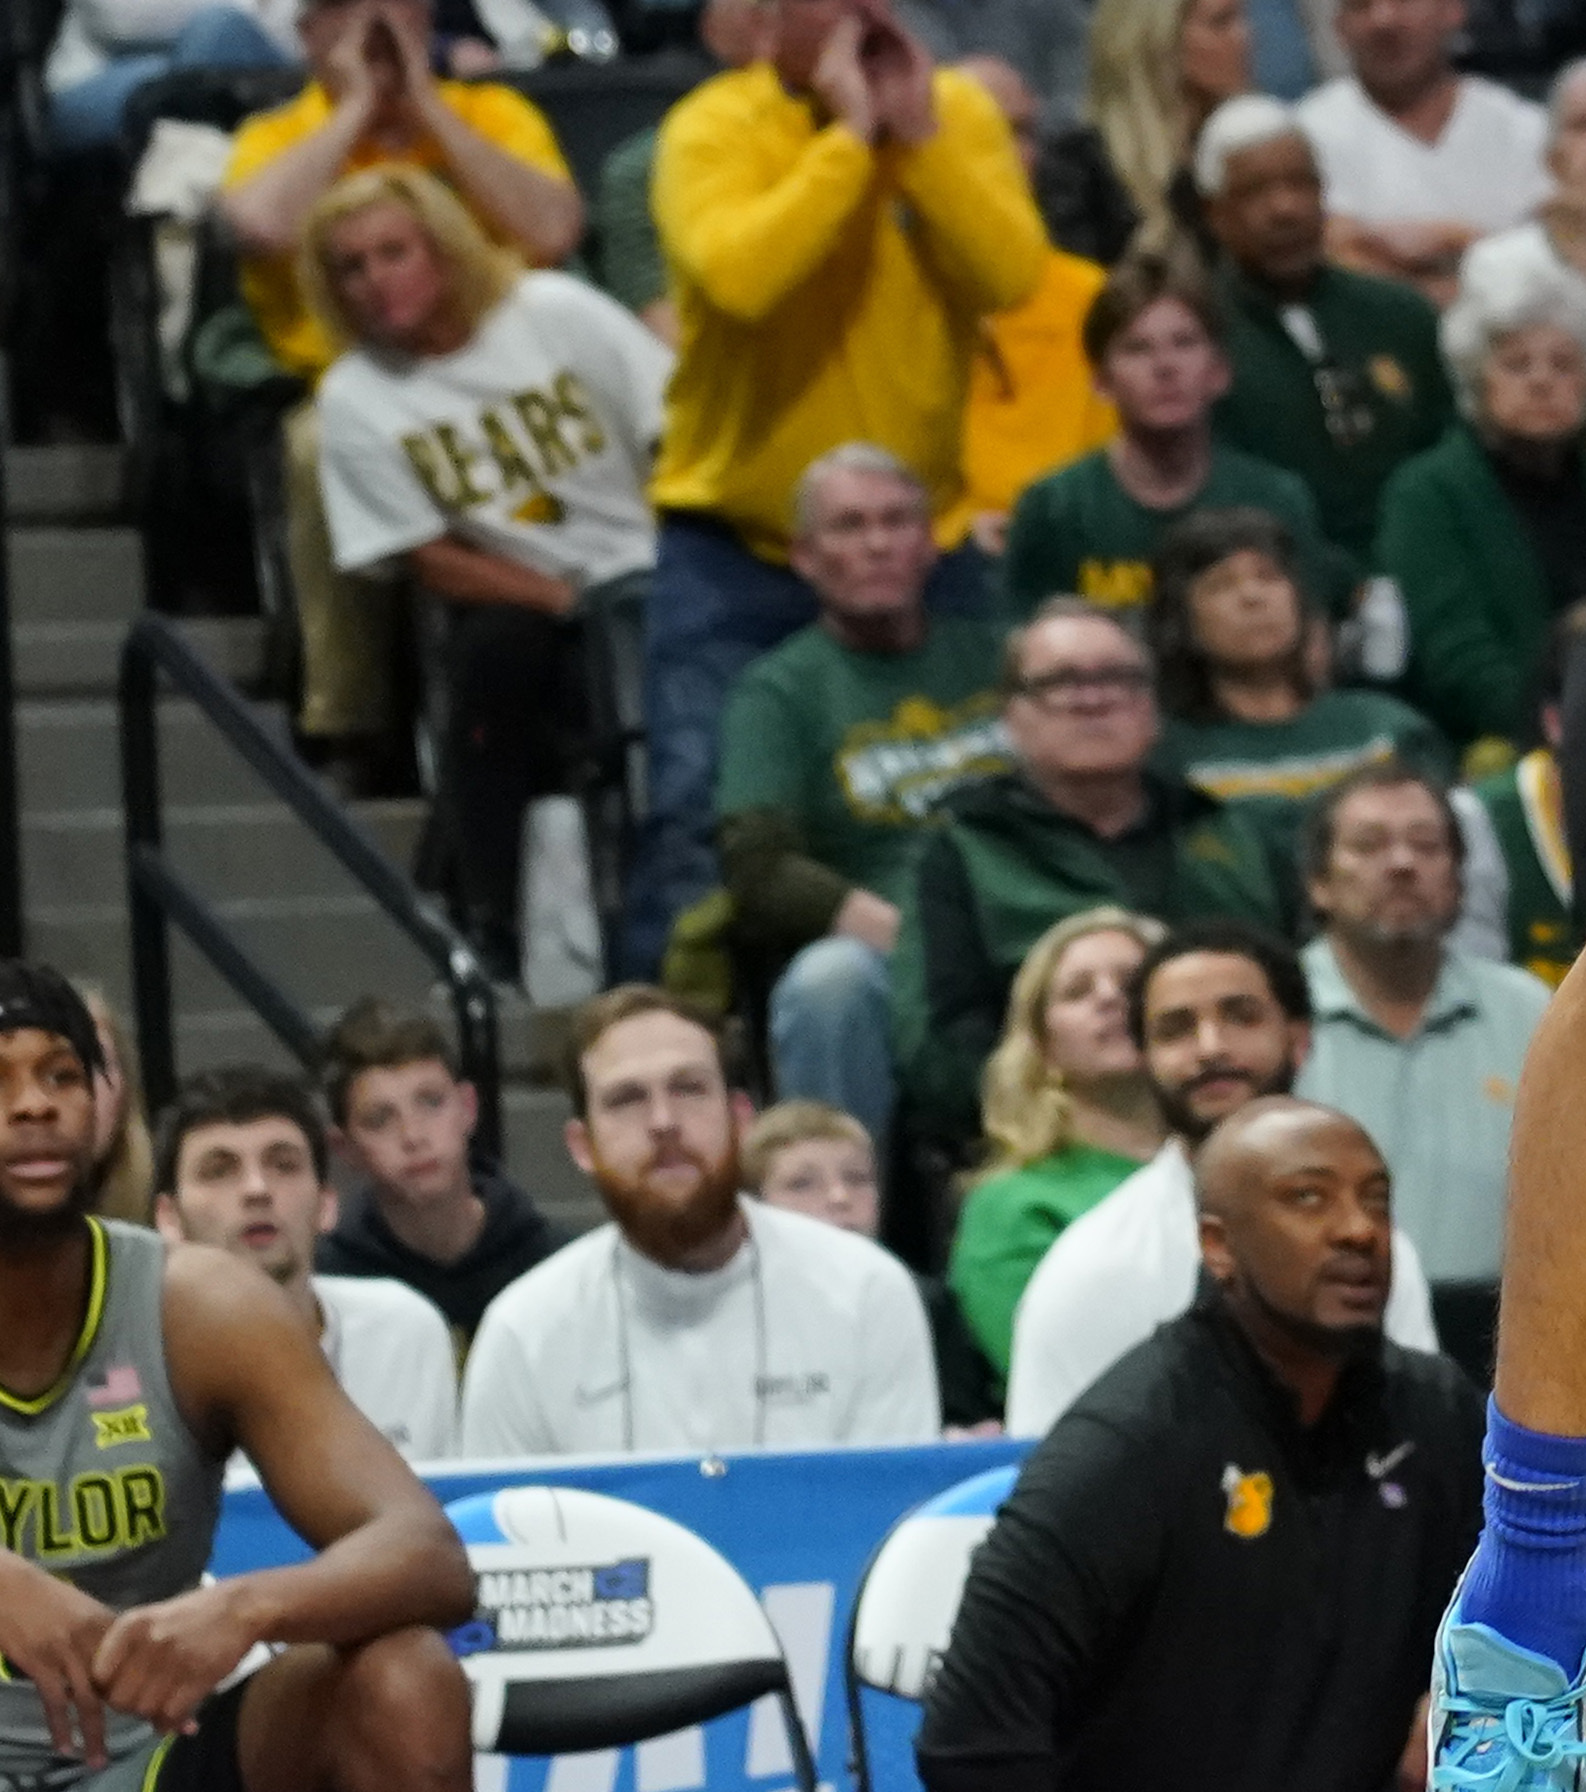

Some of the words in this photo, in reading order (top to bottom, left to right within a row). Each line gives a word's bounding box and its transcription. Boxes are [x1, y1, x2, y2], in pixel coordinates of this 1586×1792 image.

[0, 1464, 168, 1558] YLOR
[480, 1569, 592, 1608] MARCH
[502, 1597, 650, 1642] MADNESS
